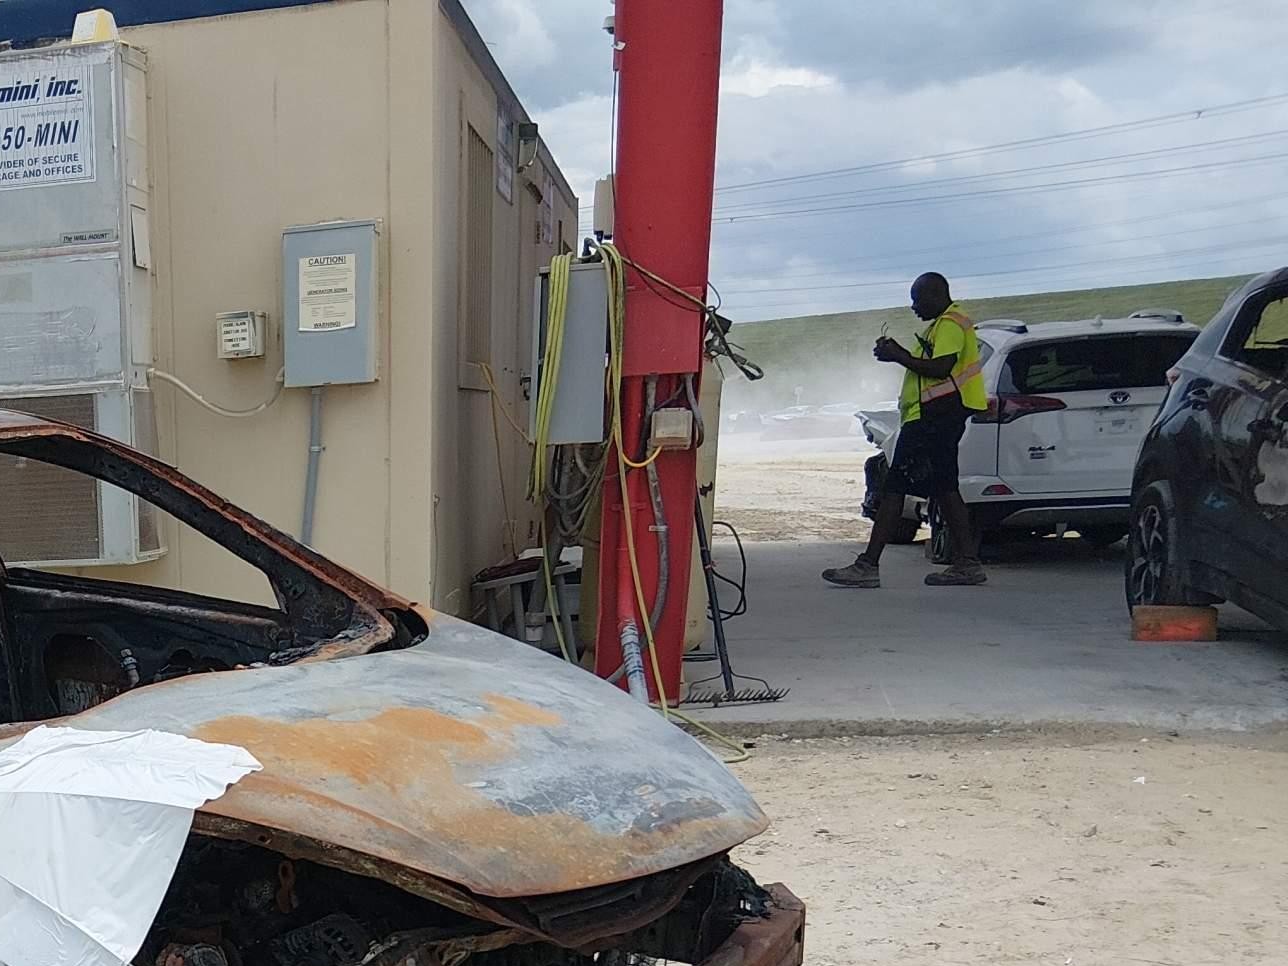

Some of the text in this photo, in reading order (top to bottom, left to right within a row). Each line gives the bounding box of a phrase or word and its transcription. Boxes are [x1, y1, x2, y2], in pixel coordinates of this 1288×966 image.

[46, 77, 82, 98] inc.
[27, 157, 40, 167] OF
[42, 153, 79, 165] SECURE
[22, 168, 42, 178] AND
[44, 165, 83, 176] OFFICES
[308, 256, 347, 266] CAUTION!
